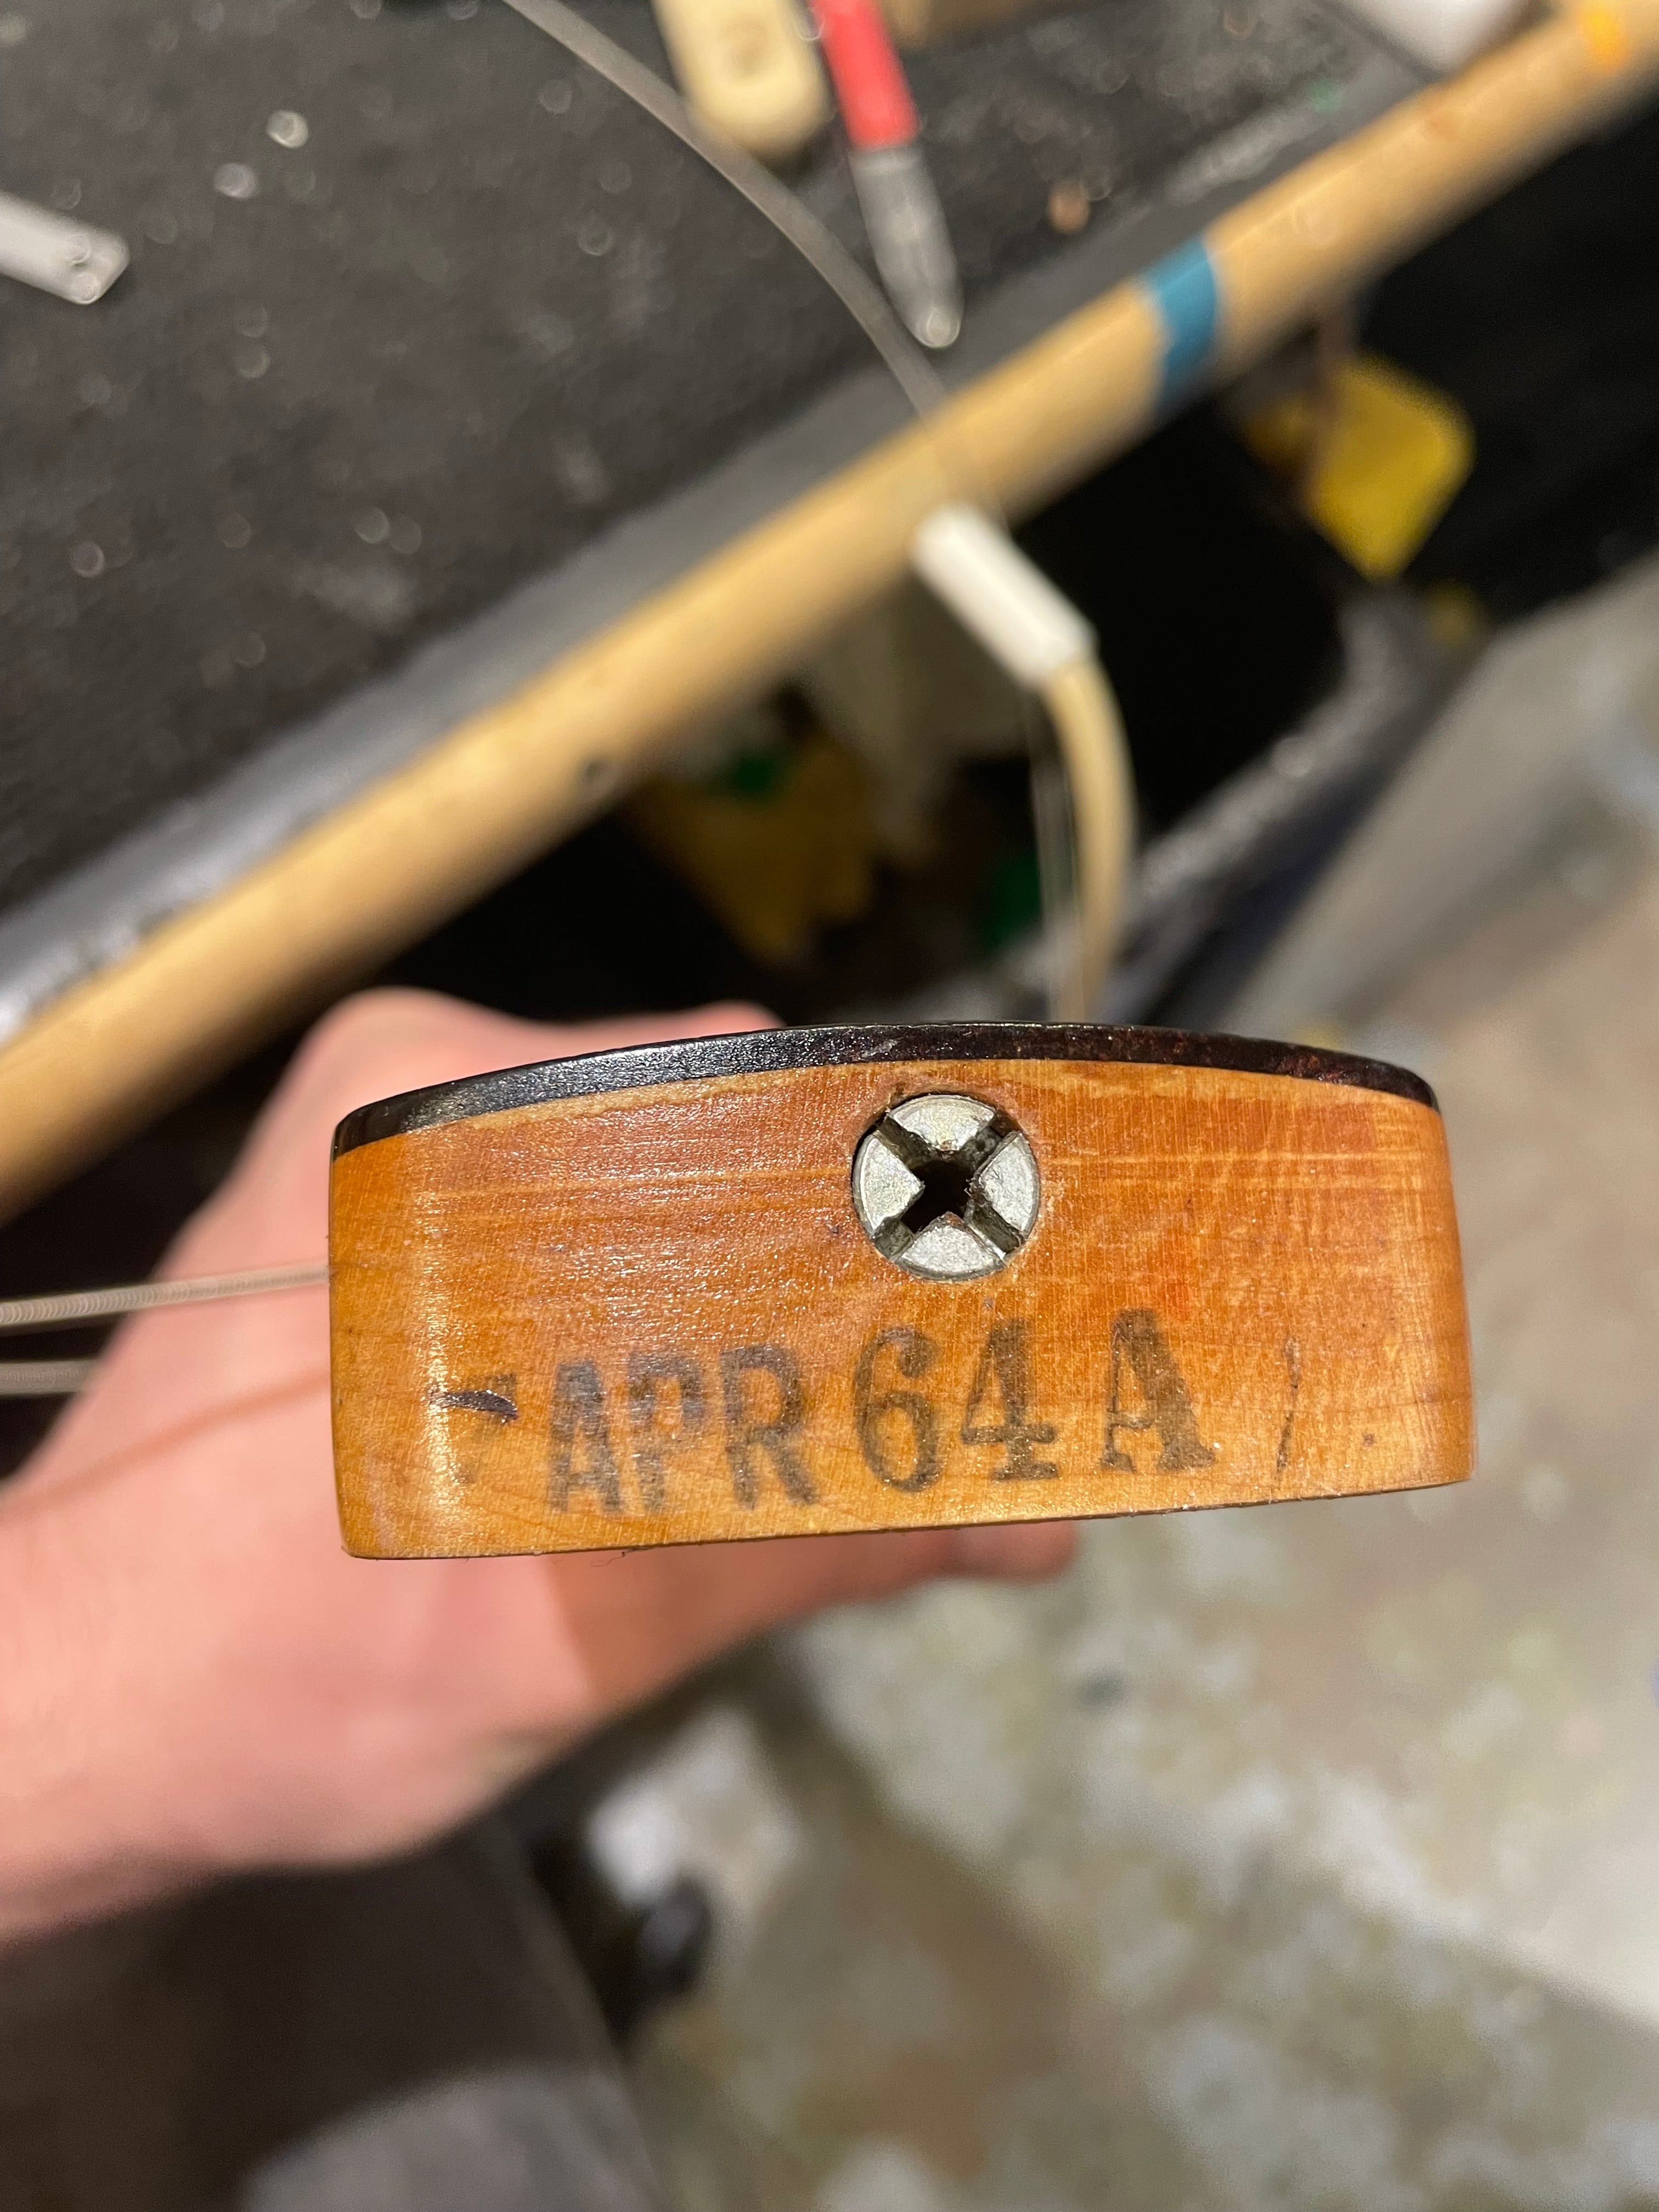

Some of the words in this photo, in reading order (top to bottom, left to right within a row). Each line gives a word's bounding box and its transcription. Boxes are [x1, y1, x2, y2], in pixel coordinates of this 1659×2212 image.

[549, 1343, 821, 1512] APR
[852, 1318, 1059, 1492] 64
[1099, 1308, 1216, 1473] A
